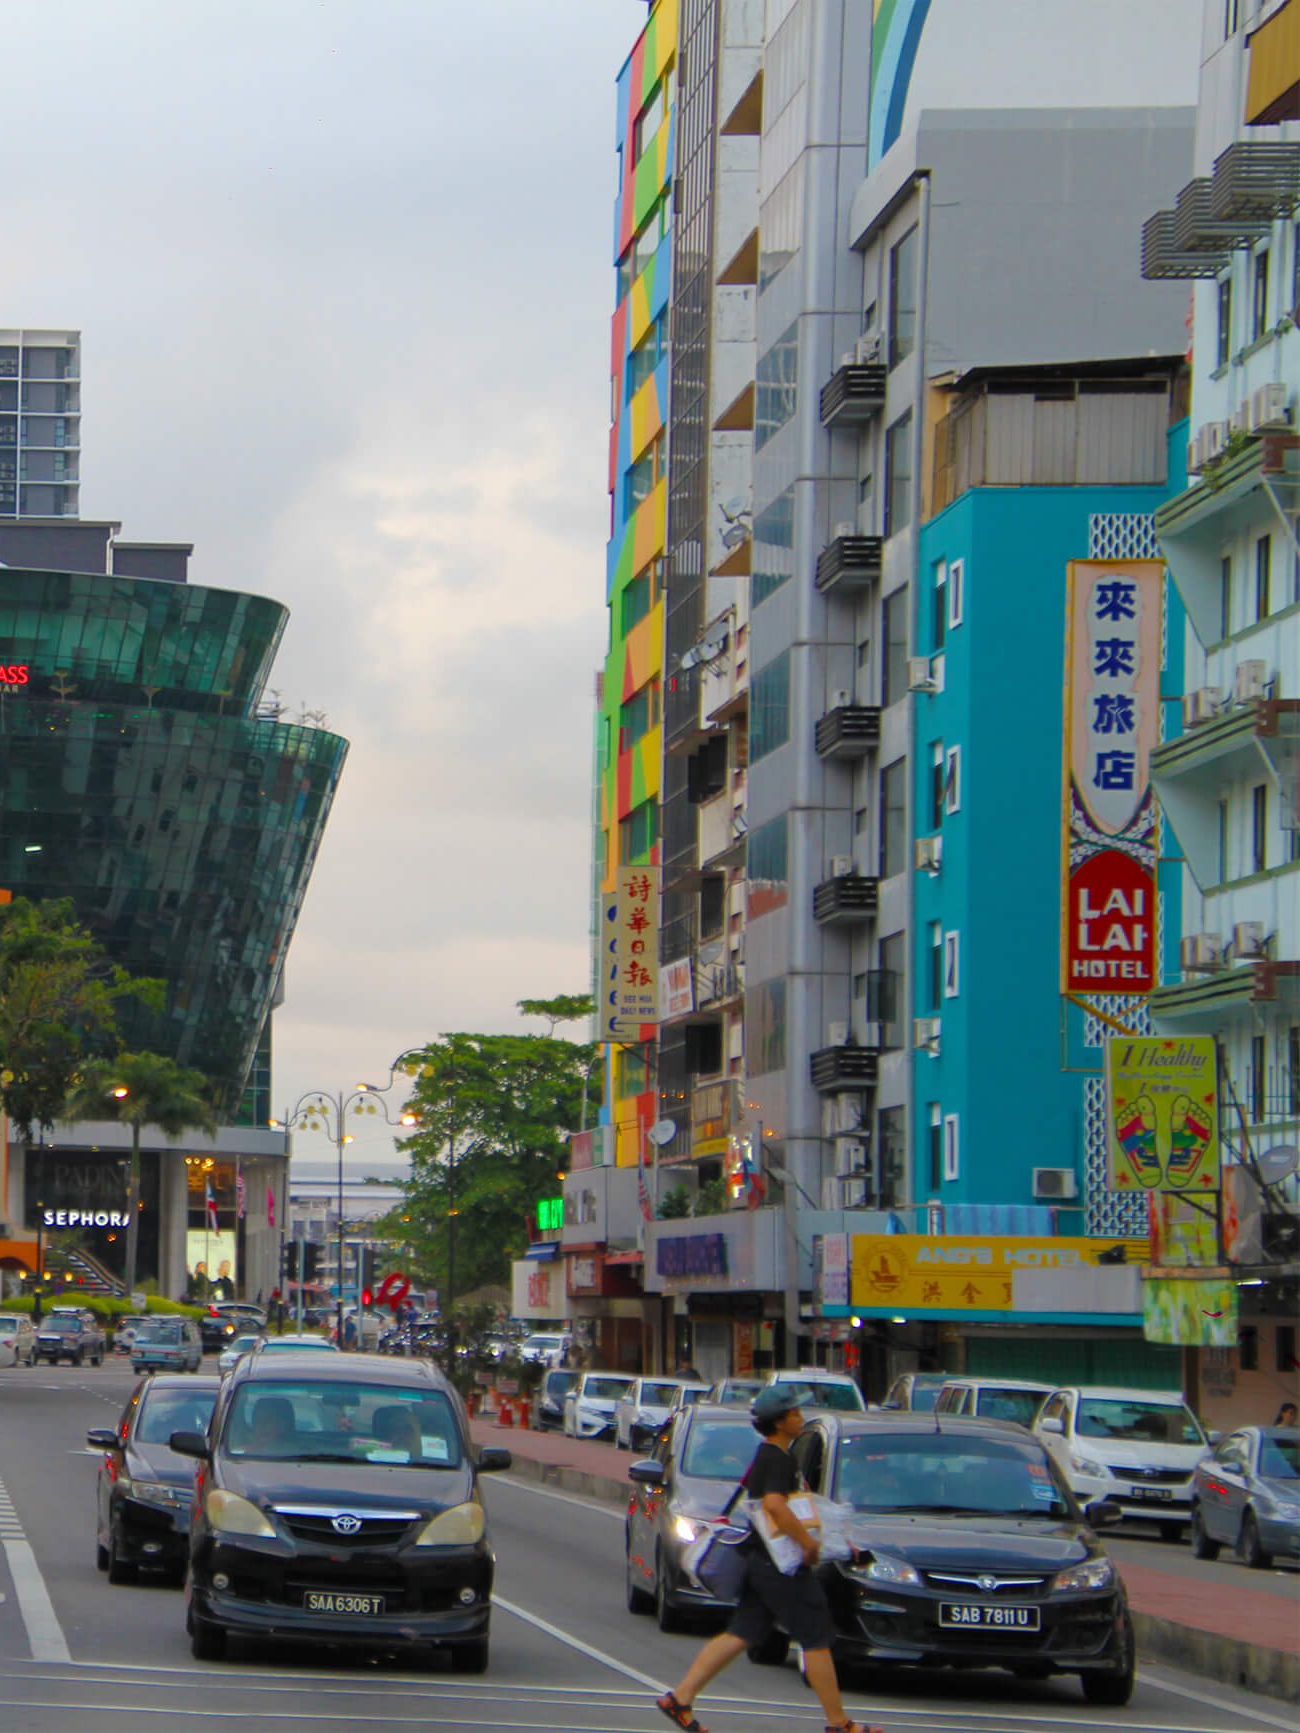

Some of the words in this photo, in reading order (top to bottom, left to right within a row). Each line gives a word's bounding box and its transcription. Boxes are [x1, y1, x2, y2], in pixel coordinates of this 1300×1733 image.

[1092, 581, 1136, 791] 來來旅店
[1078, 887, 1145, 919] LAI
[623, 874, 653, 988] 詩華日報
[1078, 923, 1147, 951] LAI
[1073, 960, 1150, 978] HOTEL
[1138, 1043, 1207, 1071] Healthy
[916, 1247, 992, 1265] ANG'S
[1004, 1248, 1089, 1266] HOTEL
